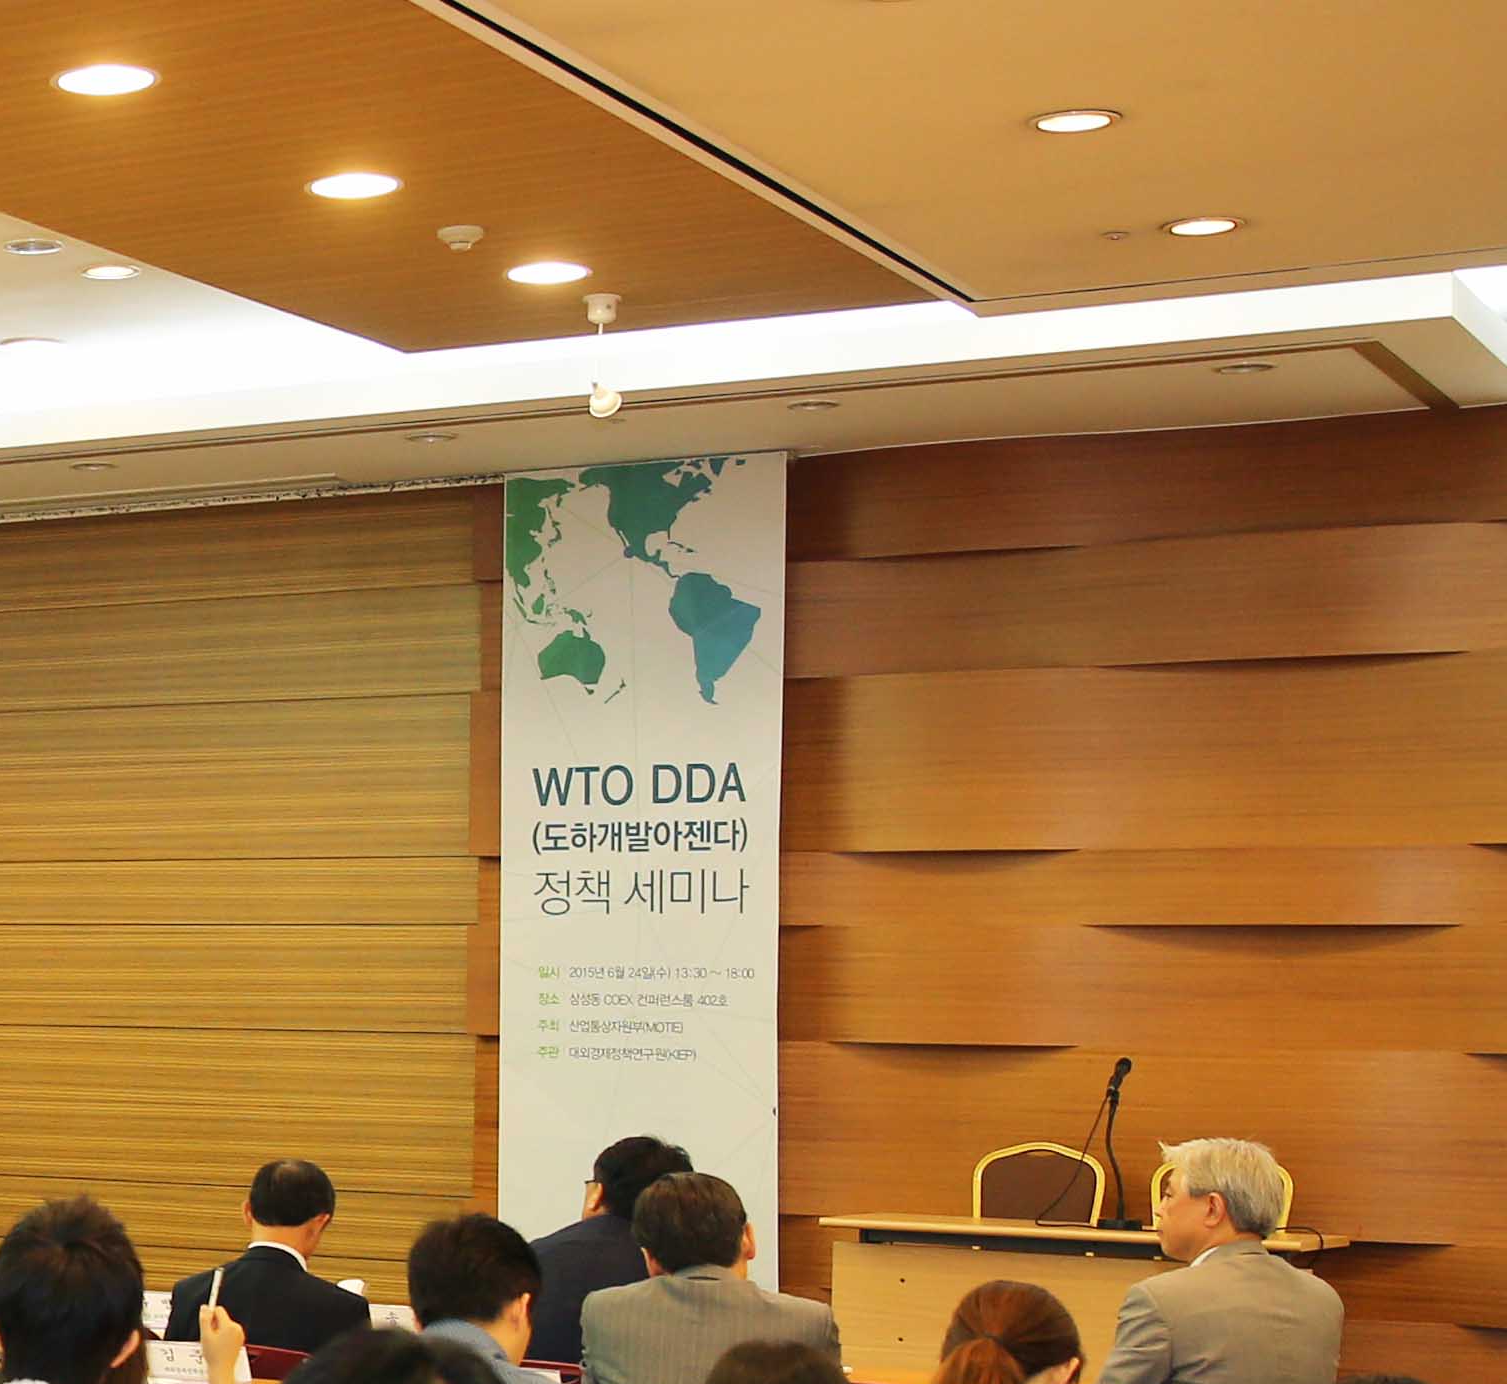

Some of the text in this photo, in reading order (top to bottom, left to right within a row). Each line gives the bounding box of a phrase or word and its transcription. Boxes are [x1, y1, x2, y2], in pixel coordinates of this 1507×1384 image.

[532, 762, 747, 806] WTO DDA
[532, 817, 748, 855] (도하개발아젠다)
[533, 868, 750, 916] 정책 세미나
[538, 966, 560, 979] 일시
[569, 966, 605, 980] 2015년
[607, 966, 625, 980] 6월
[675, 967, 708, 979] 13:30
[725, 967, 756, 980] 18:00
[603, 994, 635, 1007] COEX
[697, 994, 729, 1007] 402호
